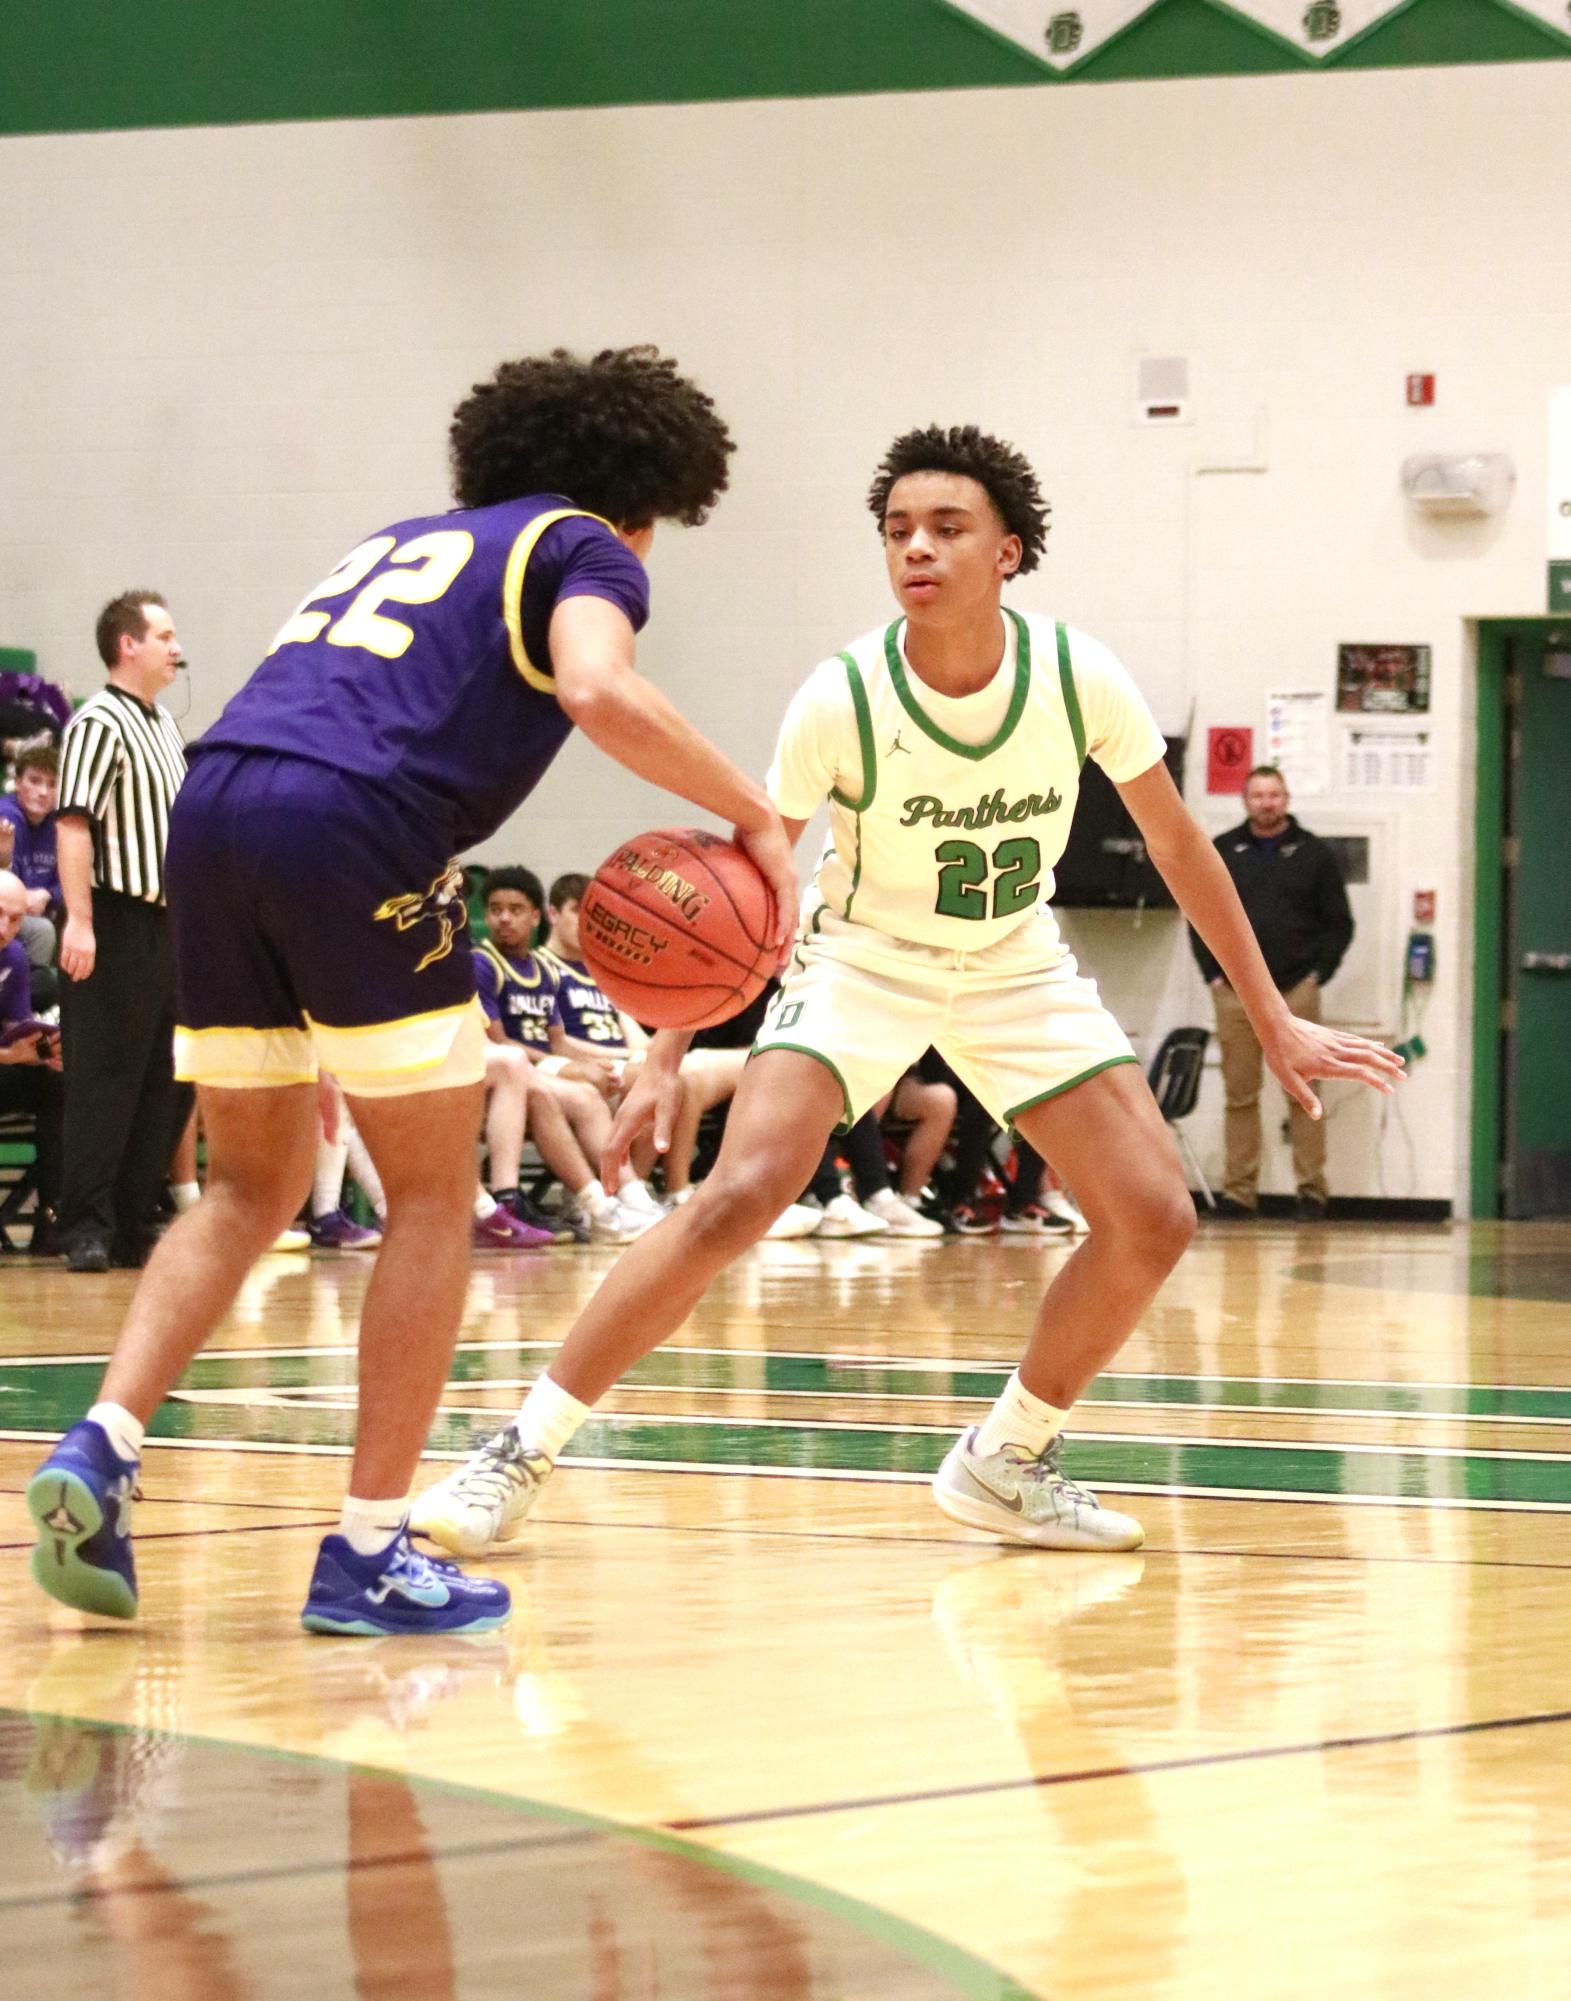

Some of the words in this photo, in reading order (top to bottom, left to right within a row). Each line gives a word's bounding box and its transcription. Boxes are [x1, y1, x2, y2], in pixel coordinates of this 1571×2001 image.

[267, 530, 474, 659] 22
[900, 788, 1063, 830] Panthers
[607, 848, 710, 921] PALDING
[934, 836, 1041, 920] 22
[585, 894, 669, 953] LEGACY
[774, 999, 808, 1032] D
